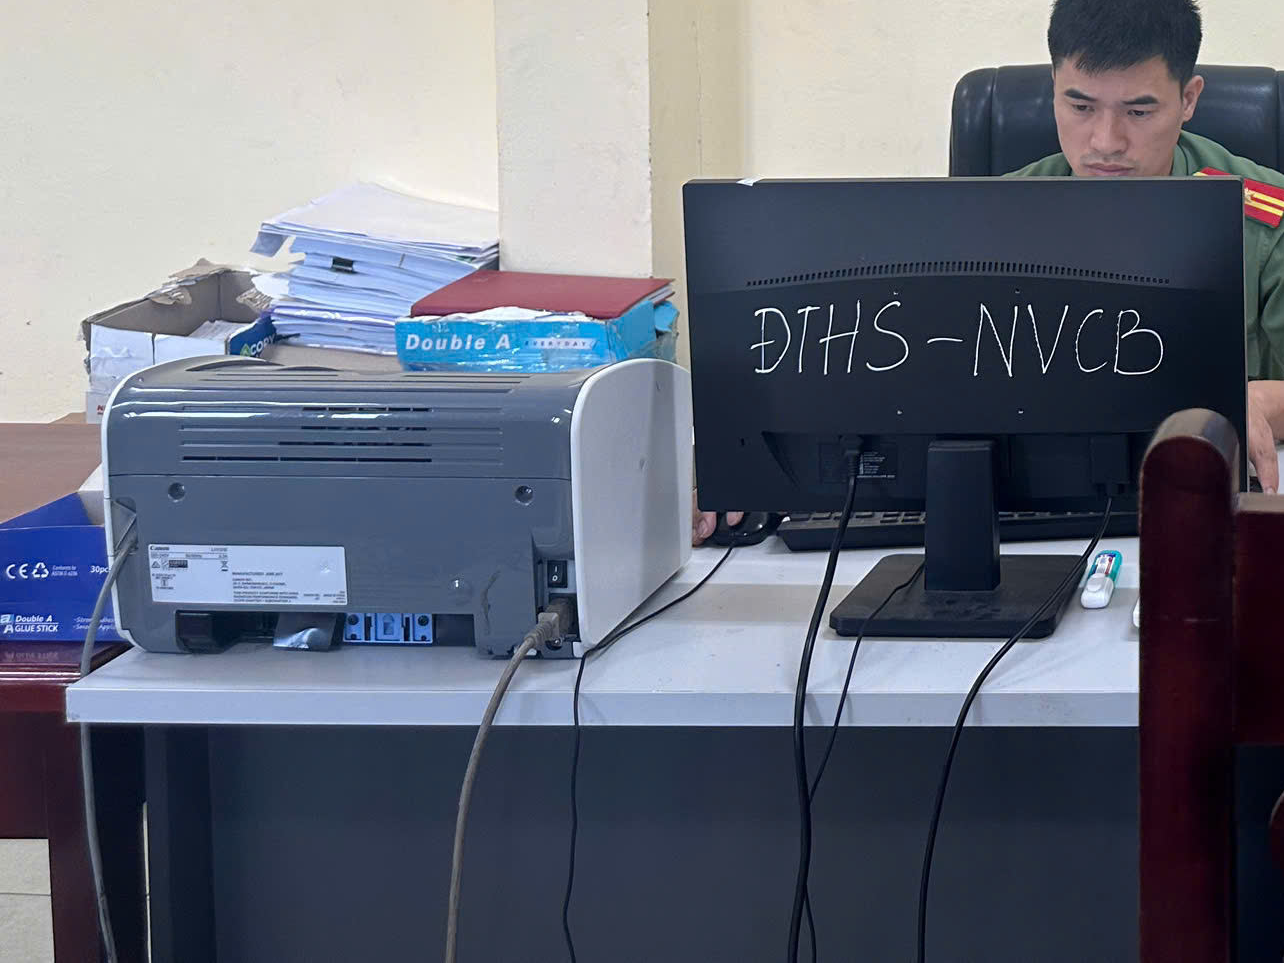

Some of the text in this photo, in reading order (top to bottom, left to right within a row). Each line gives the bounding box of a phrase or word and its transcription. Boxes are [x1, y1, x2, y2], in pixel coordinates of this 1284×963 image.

[405, 333, 486, 351] Double
[495, 333, 511, 350] A
[751, 300, 909, 375] ĐTHS
[974, 303, 1164, 377] NVCB
[90, 565, 110, 574] 30pc
[15, 615, 44, 623] Double
[15, 624, 59, 632] GLUE STICK
